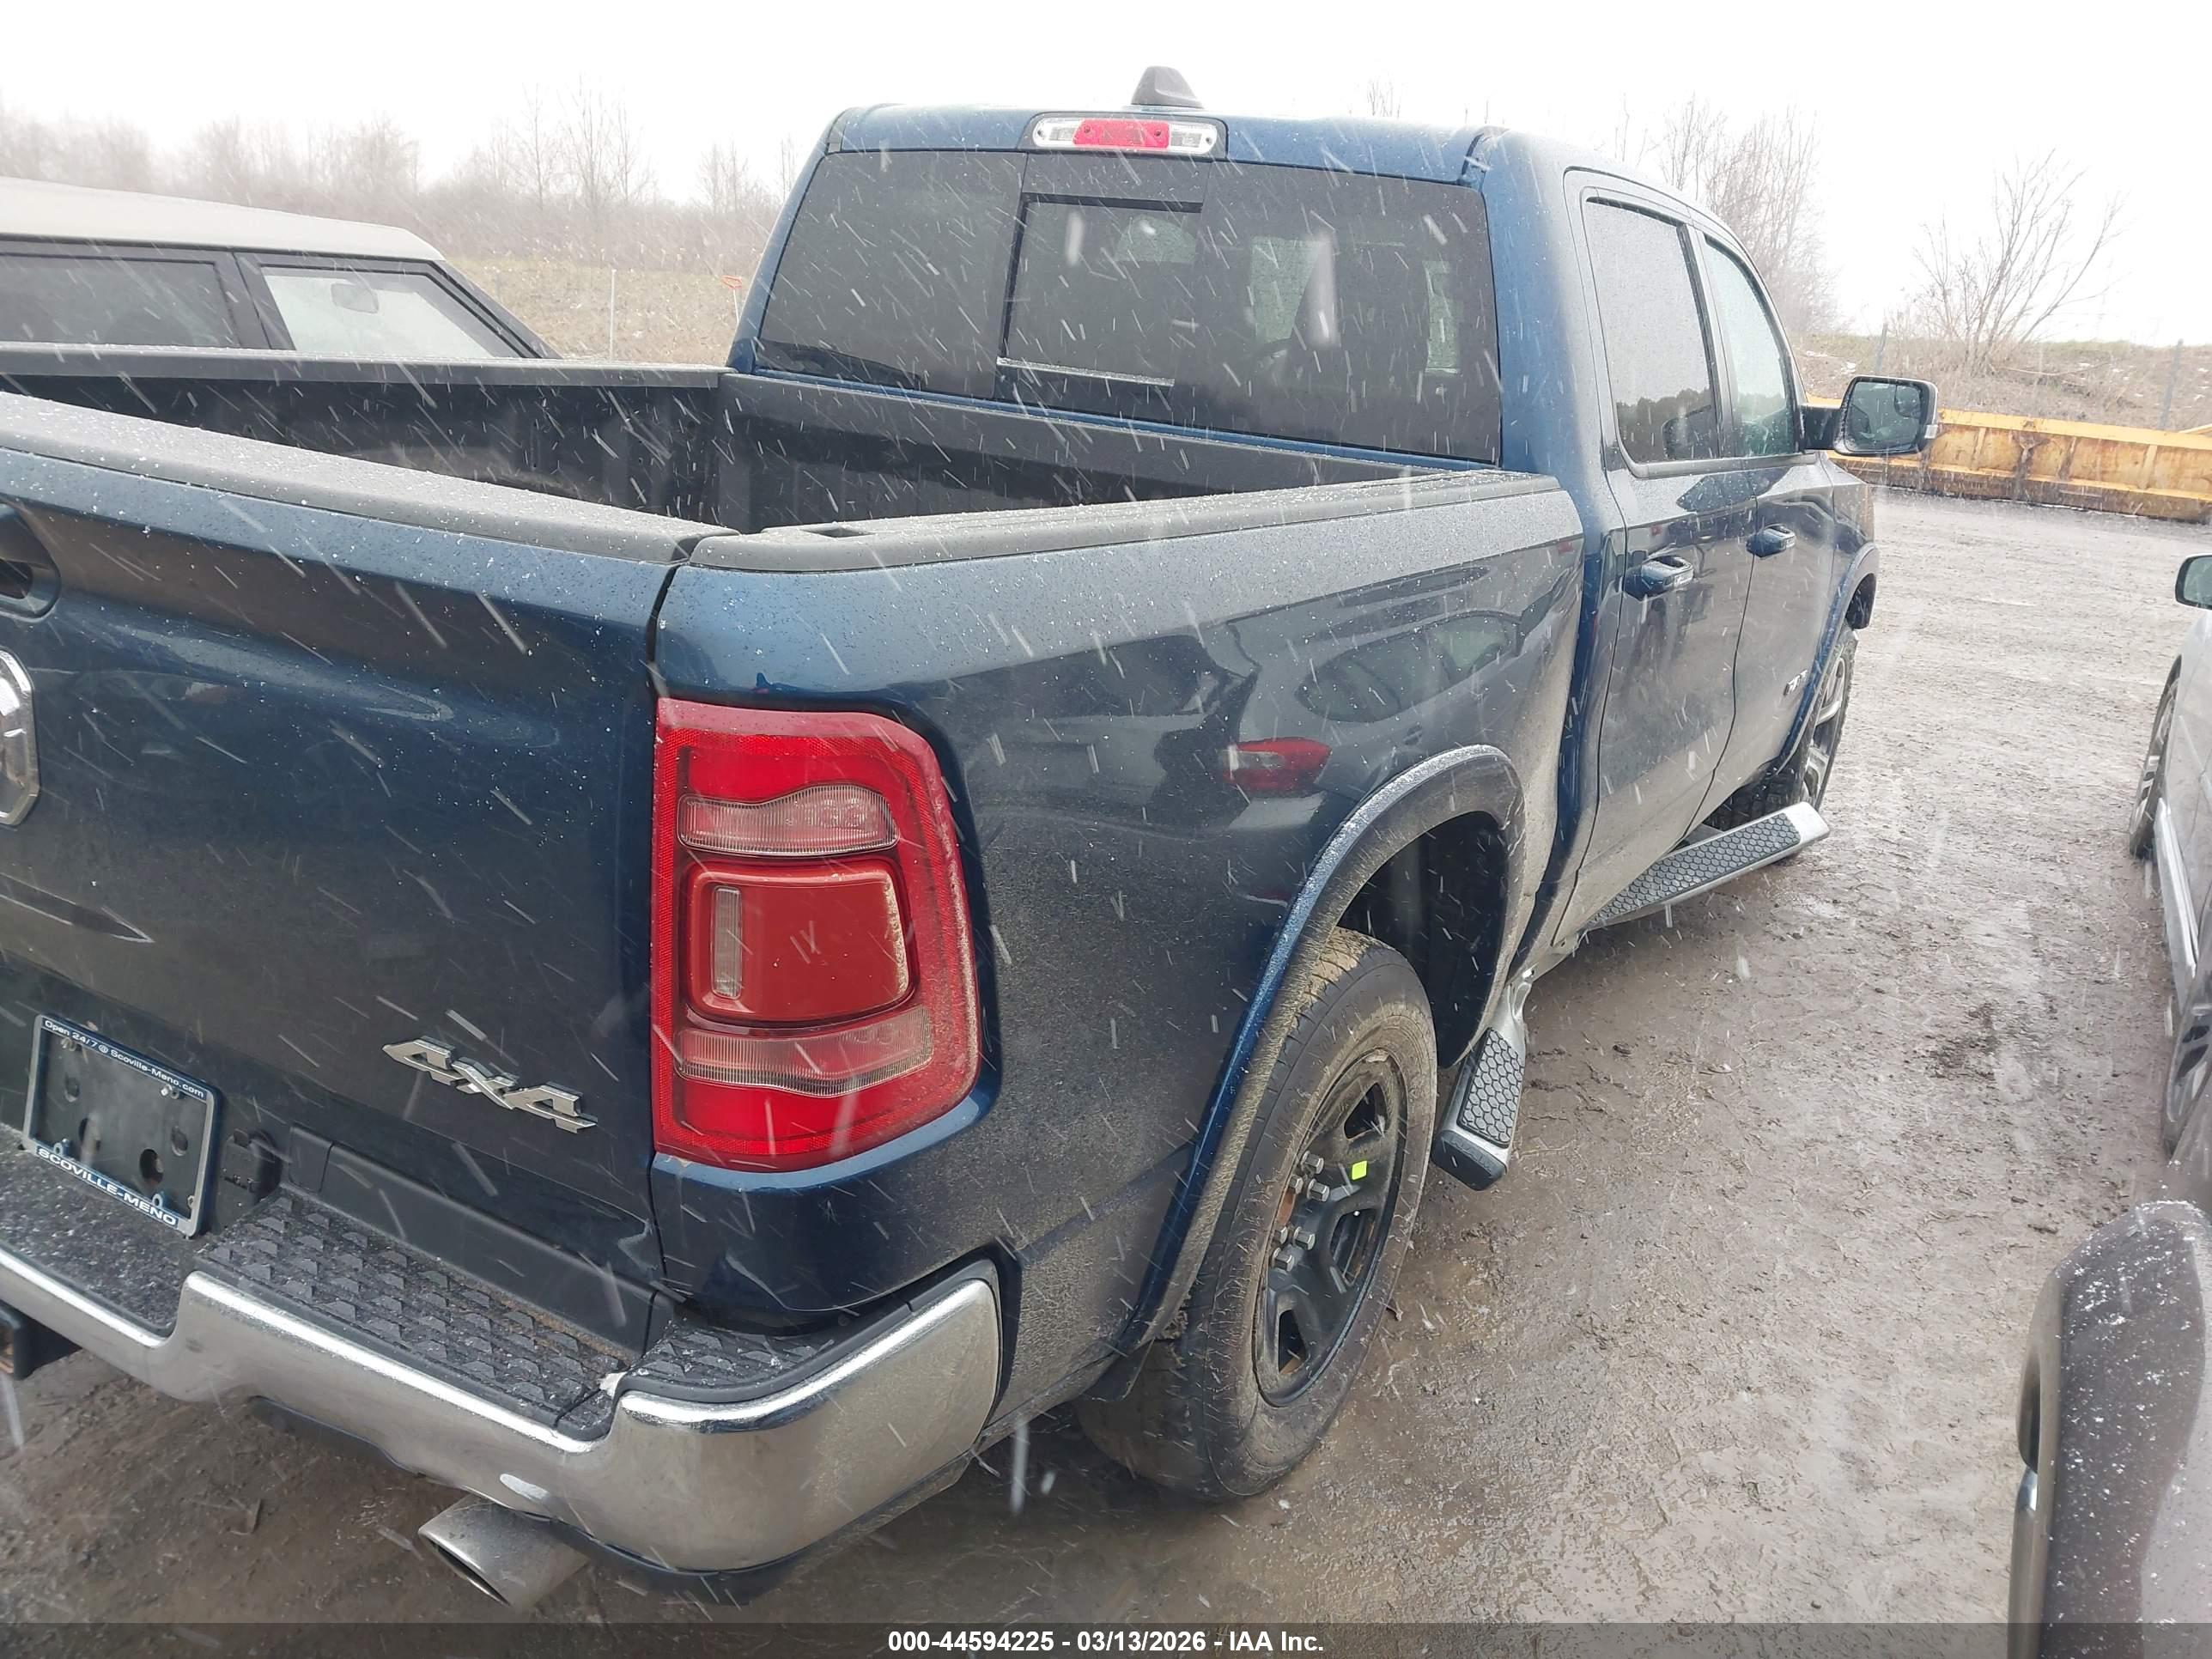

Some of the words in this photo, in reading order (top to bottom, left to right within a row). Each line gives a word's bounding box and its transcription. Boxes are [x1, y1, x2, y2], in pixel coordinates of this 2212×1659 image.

[45, 1019, 70, 1036] Open
[72, 1031, 98, 1048] 24/7
[110, 1048, 204, 1098] Scoville-Meno.com
[38, 1147, 177, 1226] SCOVILLE-MENO
